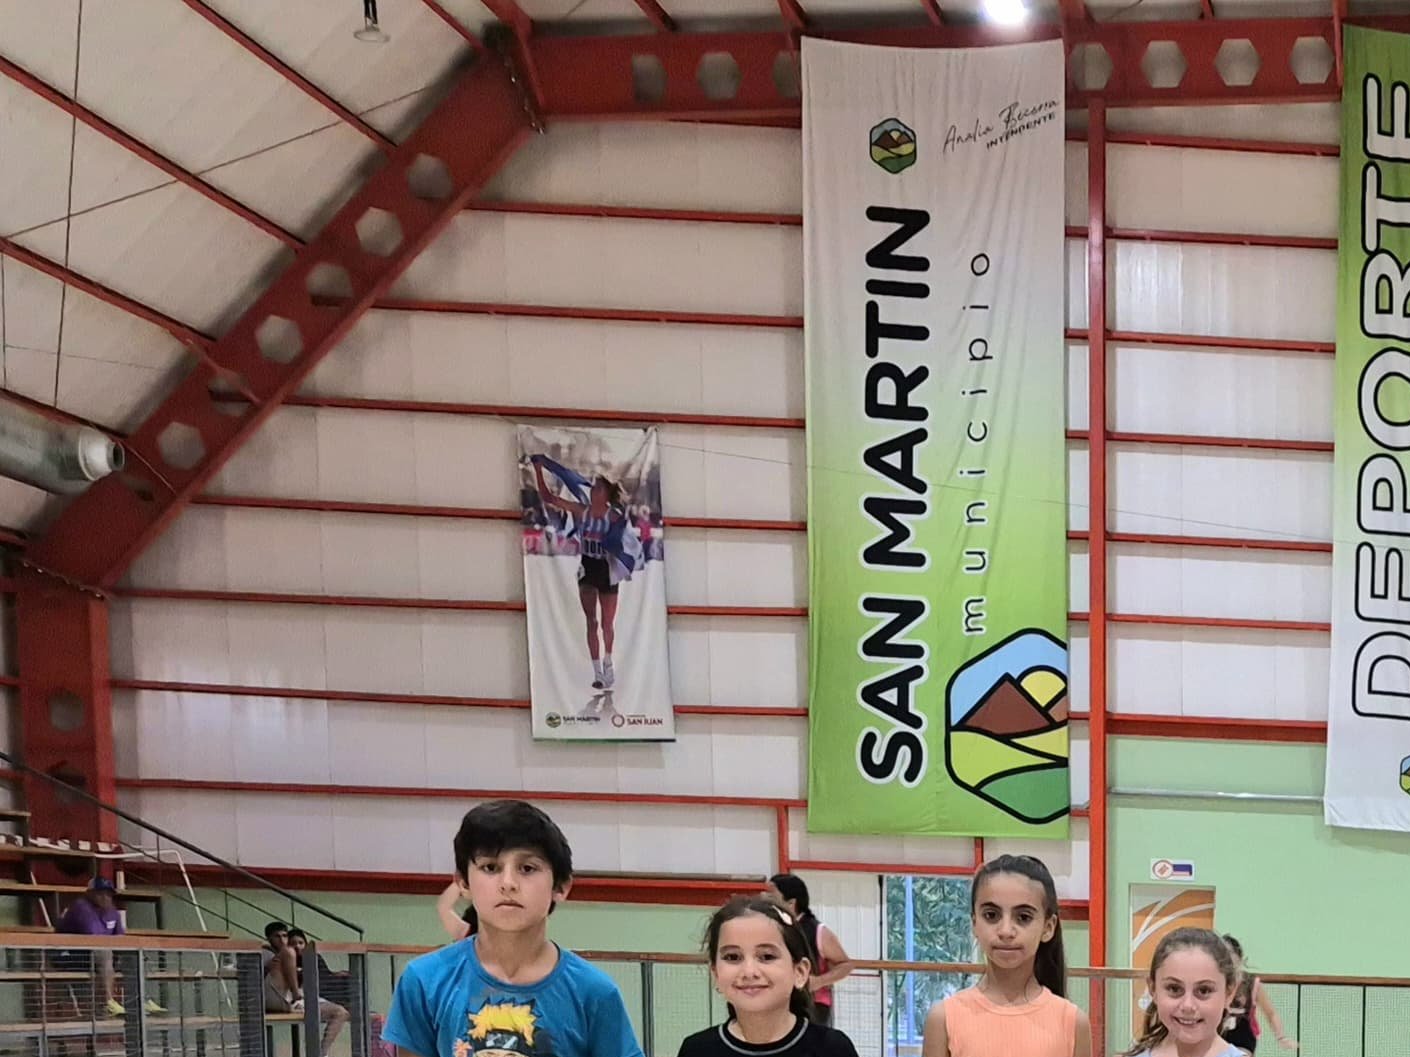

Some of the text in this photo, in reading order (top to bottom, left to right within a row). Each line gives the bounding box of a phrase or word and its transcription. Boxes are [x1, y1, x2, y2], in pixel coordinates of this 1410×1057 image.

[987, 112, 1055, 150] INTENDENTE
[861, 205, 931, 782] SAN MARTIN
[960, 252, 993, 634] municipio
